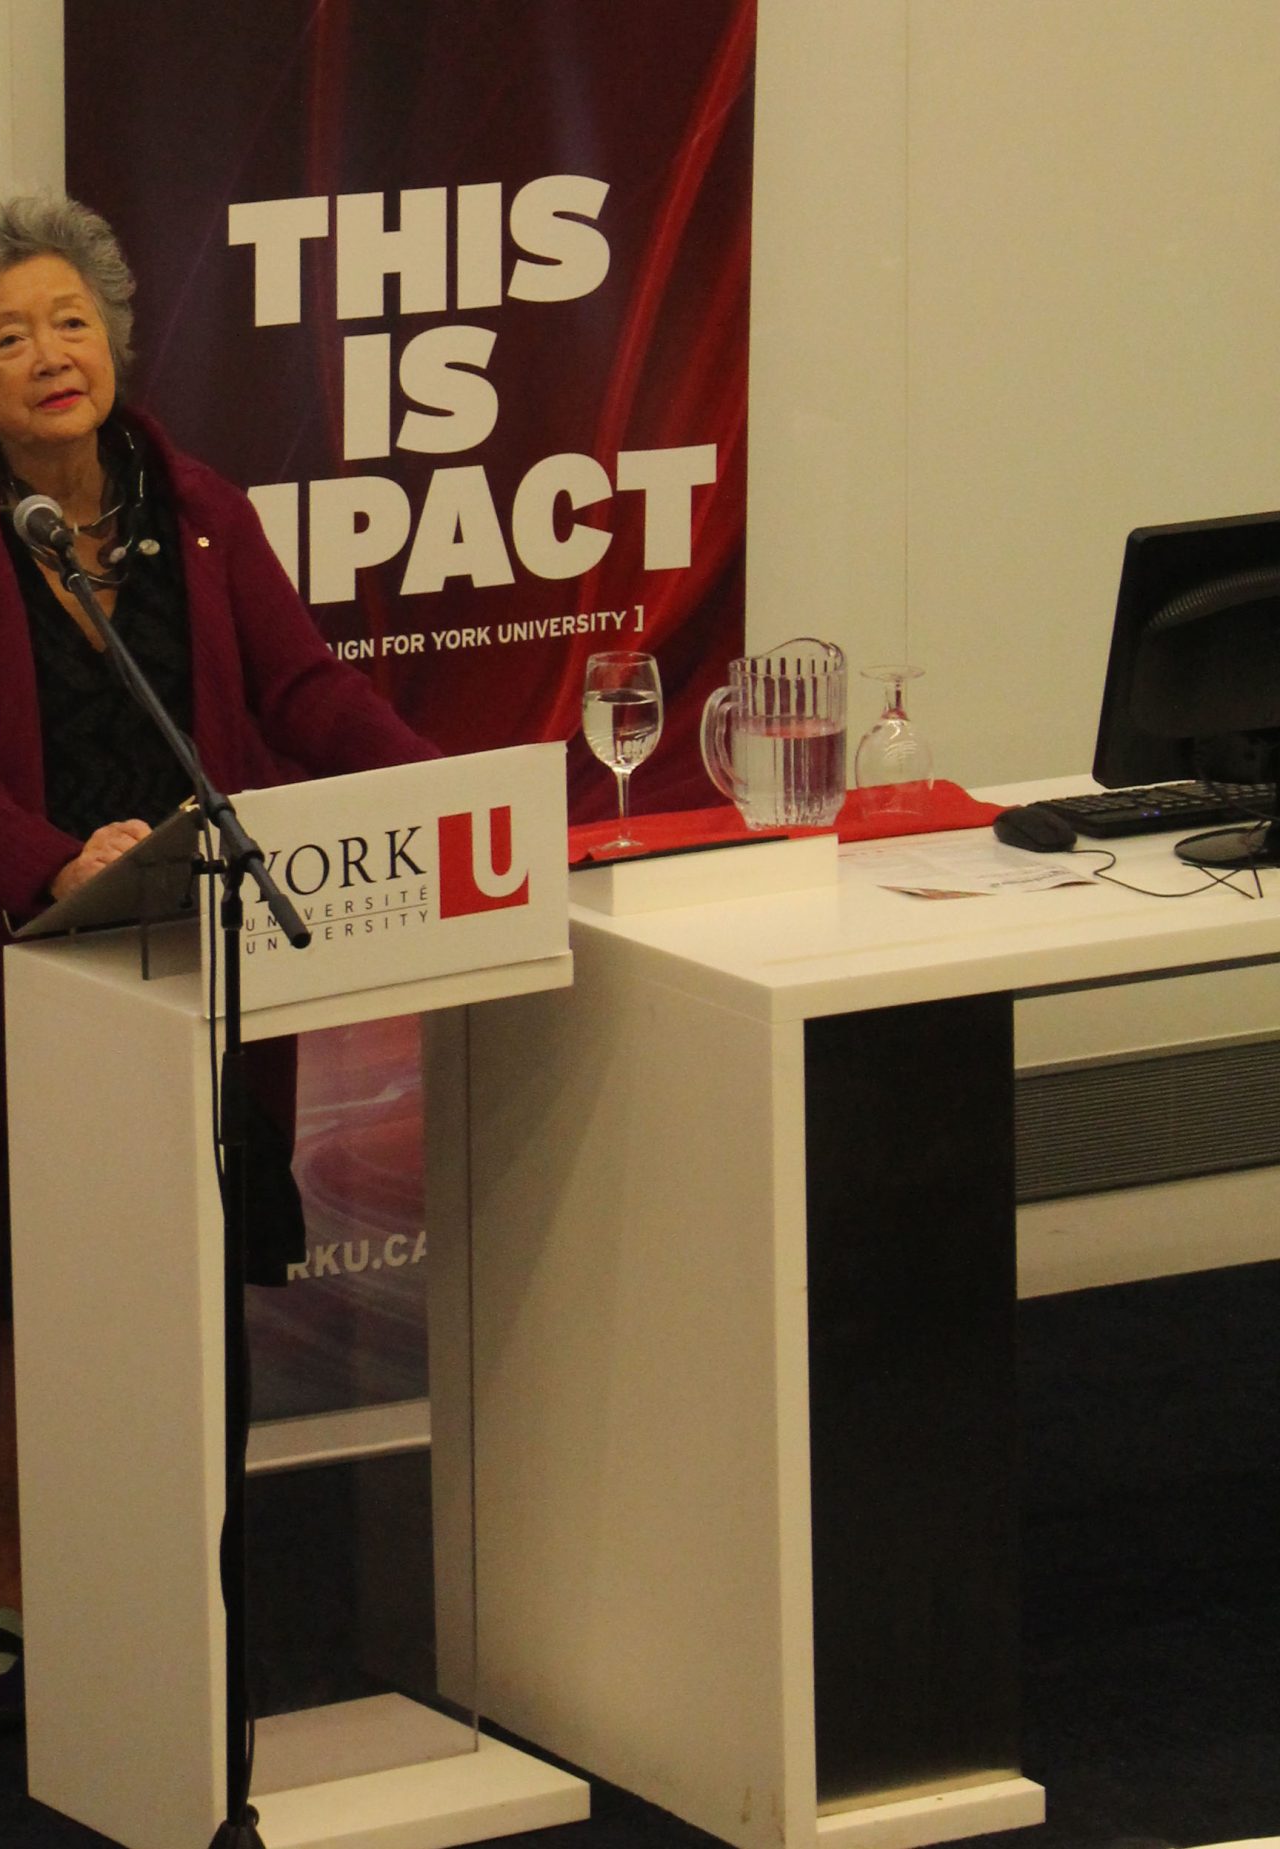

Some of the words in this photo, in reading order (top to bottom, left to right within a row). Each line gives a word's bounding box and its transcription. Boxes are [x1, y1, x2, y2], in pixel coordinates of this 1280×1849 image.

[227, 174, 611, 327] THIS
[343, 325, 499, 461] IS
[381, 633, 425, 657] FOR
[431, 625, 492, 651] YORK
[497, 610, 627, 644] UNIVERSITY
[245, 885, 428, 931] UNVERSITÉ
[246, 910, 428, 955] UNERSITY
